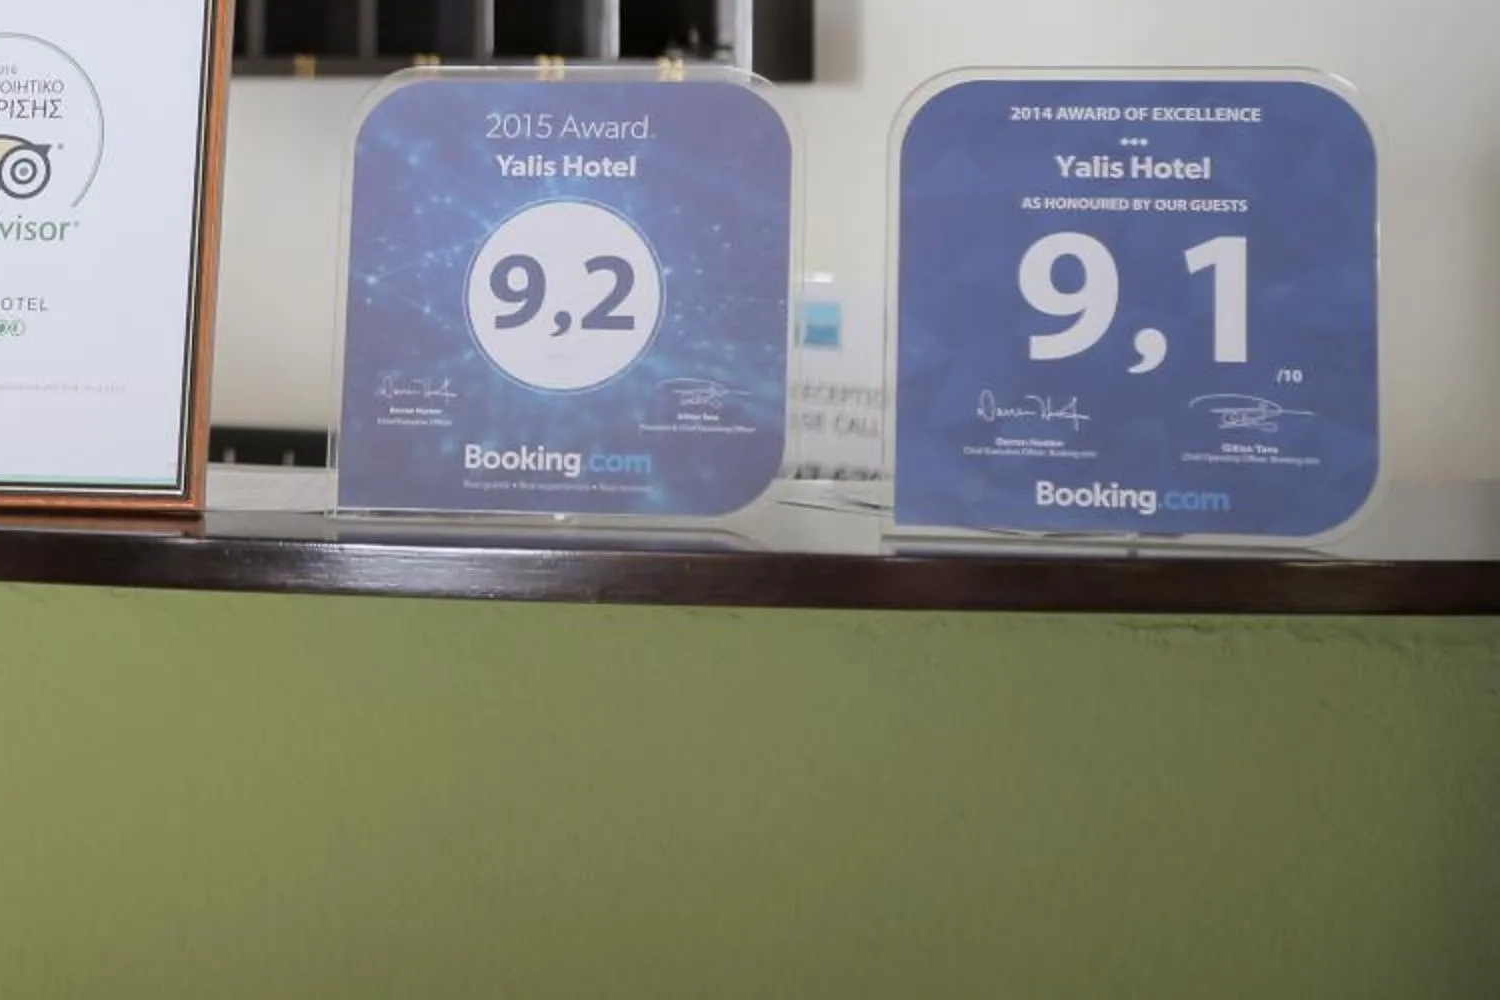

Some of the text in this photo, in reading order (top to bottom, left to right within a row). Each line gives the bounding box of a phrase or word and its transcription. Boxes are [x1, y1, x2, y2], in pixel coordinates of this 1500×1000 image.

[485, 112, 650, 140] 2015 Award
[1011, 107, 1262, 122] 2014 AWARD OF EXCELLENCE
[496, 154, 637, 178] Yalis Hotel
[1055, 155, 1211, 180] Yalis Hotel
[1022, 198, 1040, 209] AS
[1133, 199, 1151, 211] BY
[1155, 199, 1186, 212] OUR
[1191, 199, 1248, 212] GUESTS
[488, 253, 636, 337] 9,2
[1018, 231, 1248, 374] 9,1
